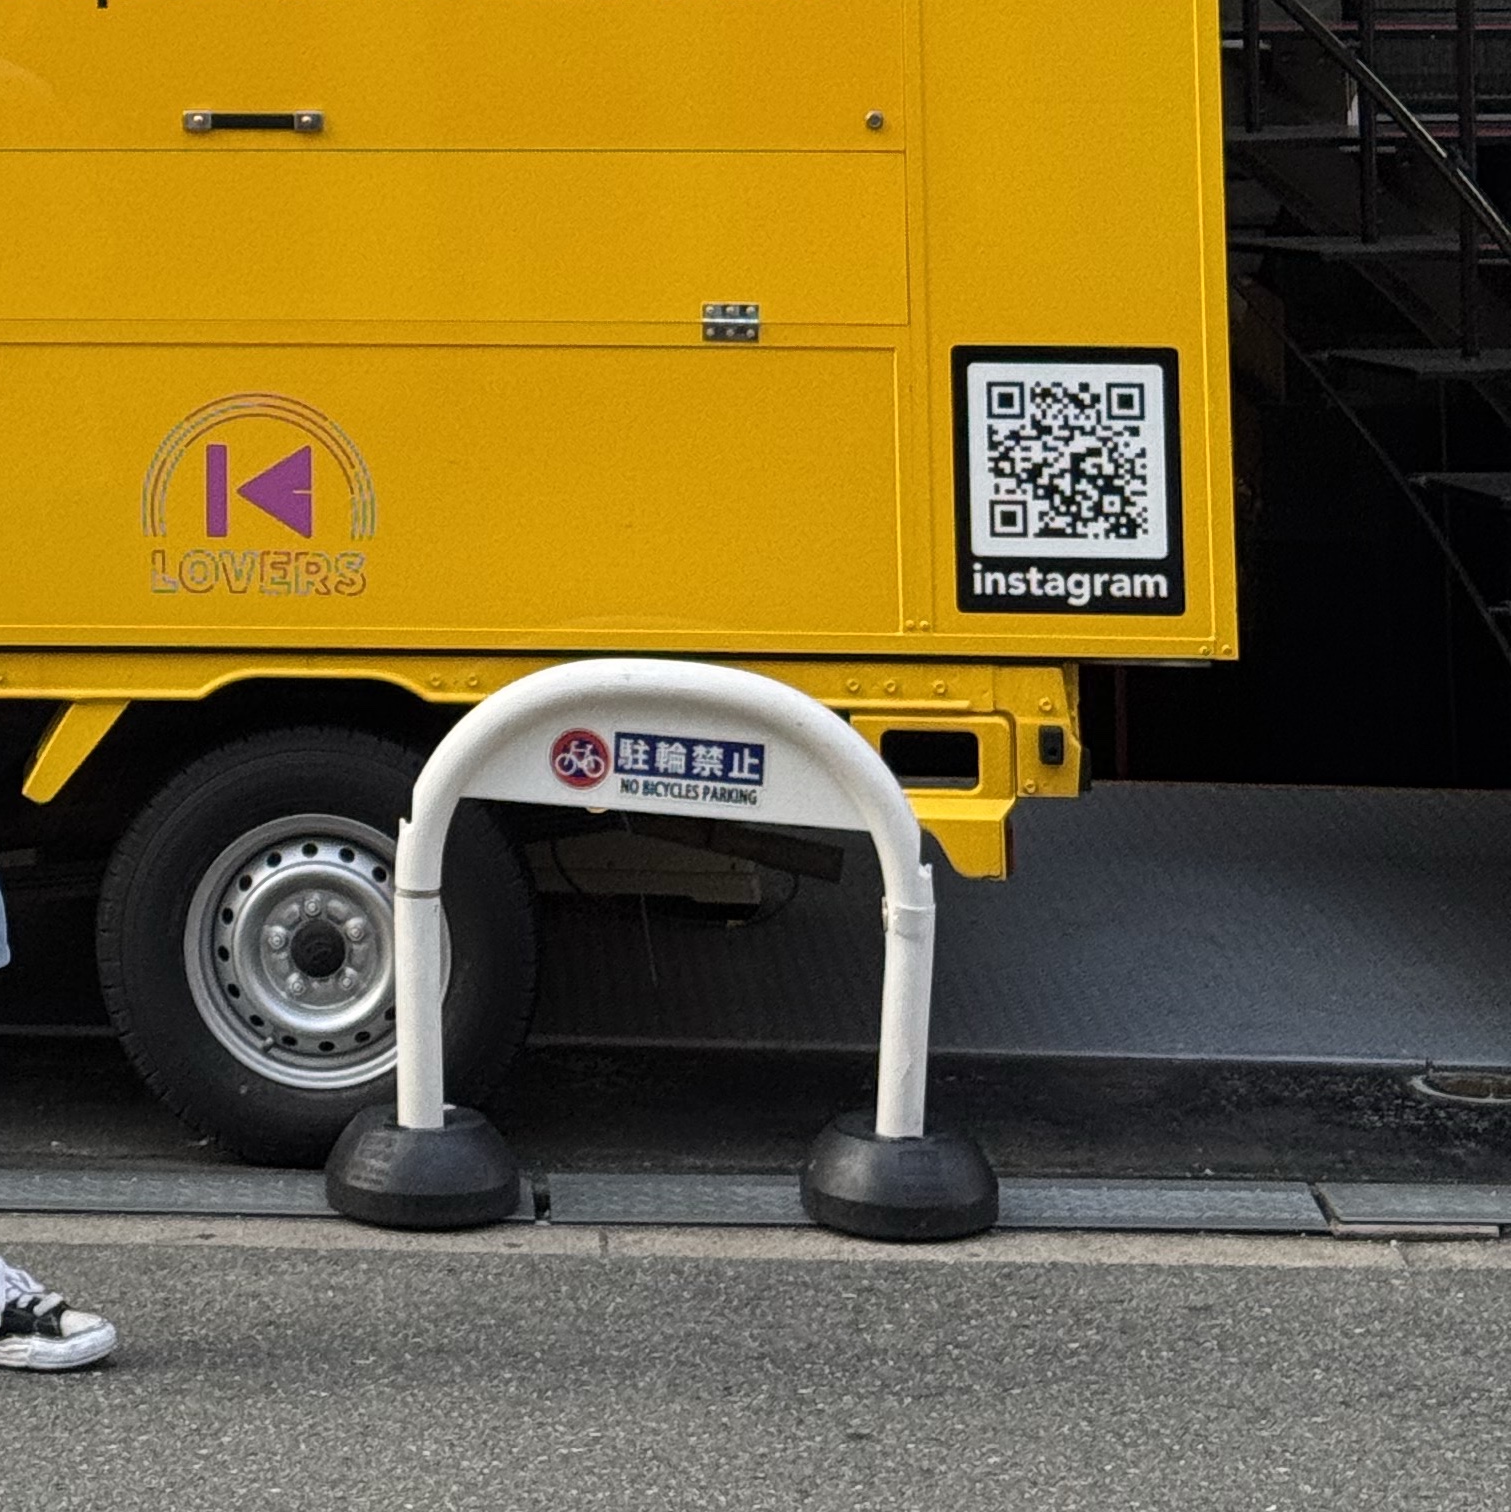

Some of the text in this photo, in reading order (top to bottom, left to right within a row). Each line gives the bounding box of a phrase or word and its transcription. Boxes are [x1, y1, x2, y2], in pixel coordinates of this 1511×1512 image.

[150, 548, 367, 597] LOVERS
[972, 563, 1170, 607] instagram
[617, 738, 761, 781] 駐輪禁止
[619, 777, 758, 806] NO BICYCLES PARKING
